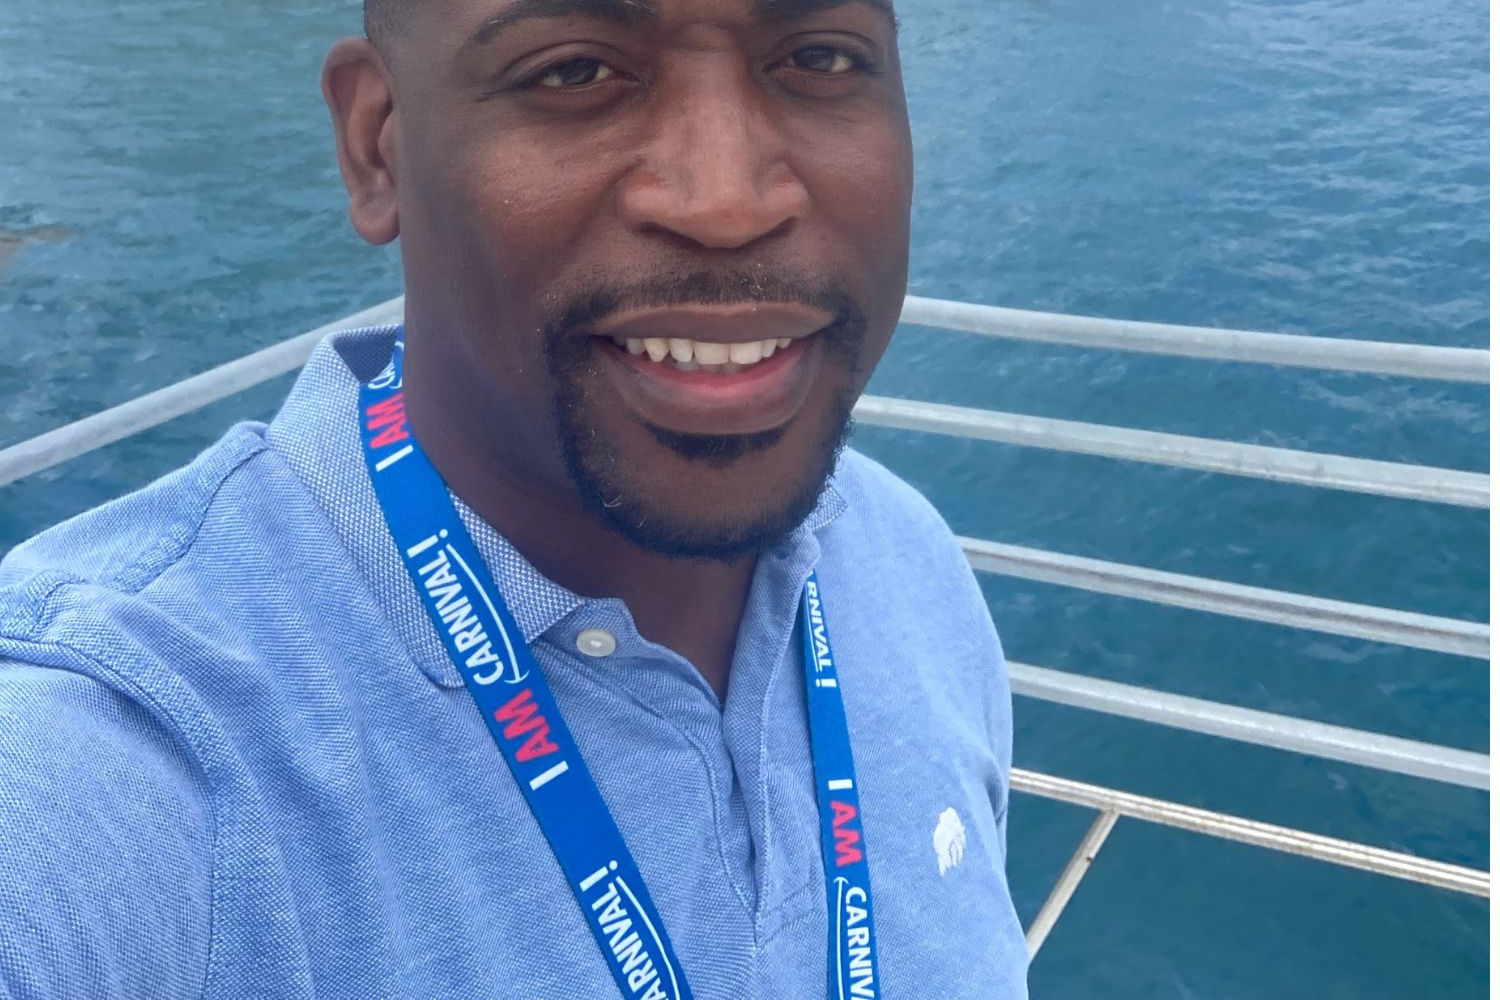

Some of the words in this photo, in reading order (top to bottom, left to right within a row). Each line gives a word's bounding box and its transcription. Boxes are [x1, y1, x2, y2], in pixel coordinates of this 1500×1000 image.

[366, 393, 409, 449] AM
[375, 444, 414, 472] I
[808, 571, 837, 687] RNIVAL!
[494, 688, 559, 763] AM
[529, 760, 569, 791] I
[828, 779, 853, 790] I
[830, 800, 862, 867] AM
[580, 860, 668, 1000] ARNIVAL!
[845, 886, 875, 1000] CARNIV
